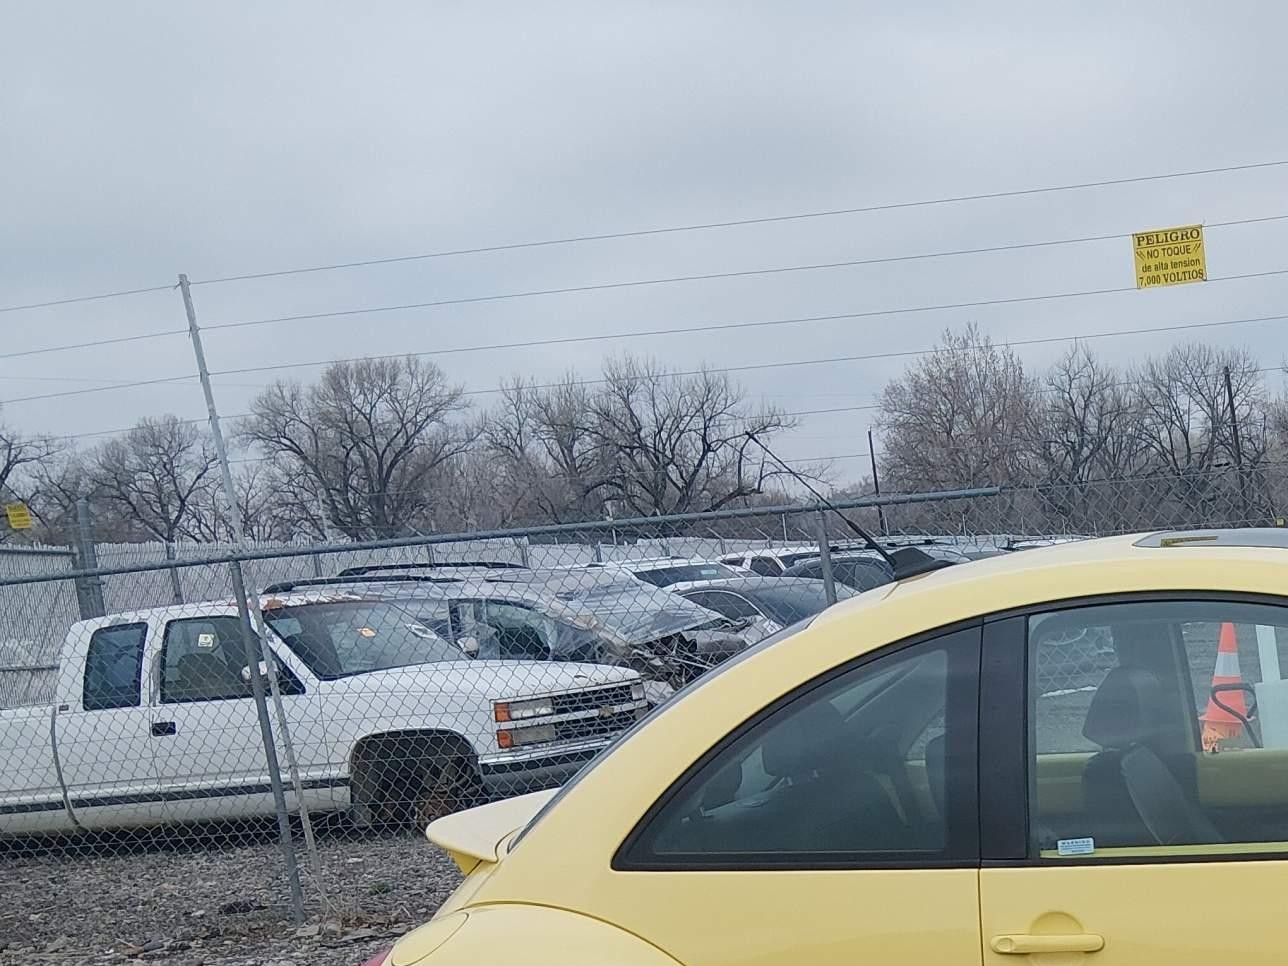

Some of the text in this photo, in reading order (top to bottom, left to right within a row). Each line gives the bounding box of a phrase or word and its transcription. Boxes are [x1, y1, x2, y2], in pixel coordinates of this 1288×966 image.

[1136, 229, 1200, 246] PELIGRO
[1147, 245, 1191, 259] NO TOQUE
[1142, 264, 1152, 273] de
[1154, 261, 1168, 271] alta
[1139, 269, 1203, 287] 7,000 VOLTIOS
